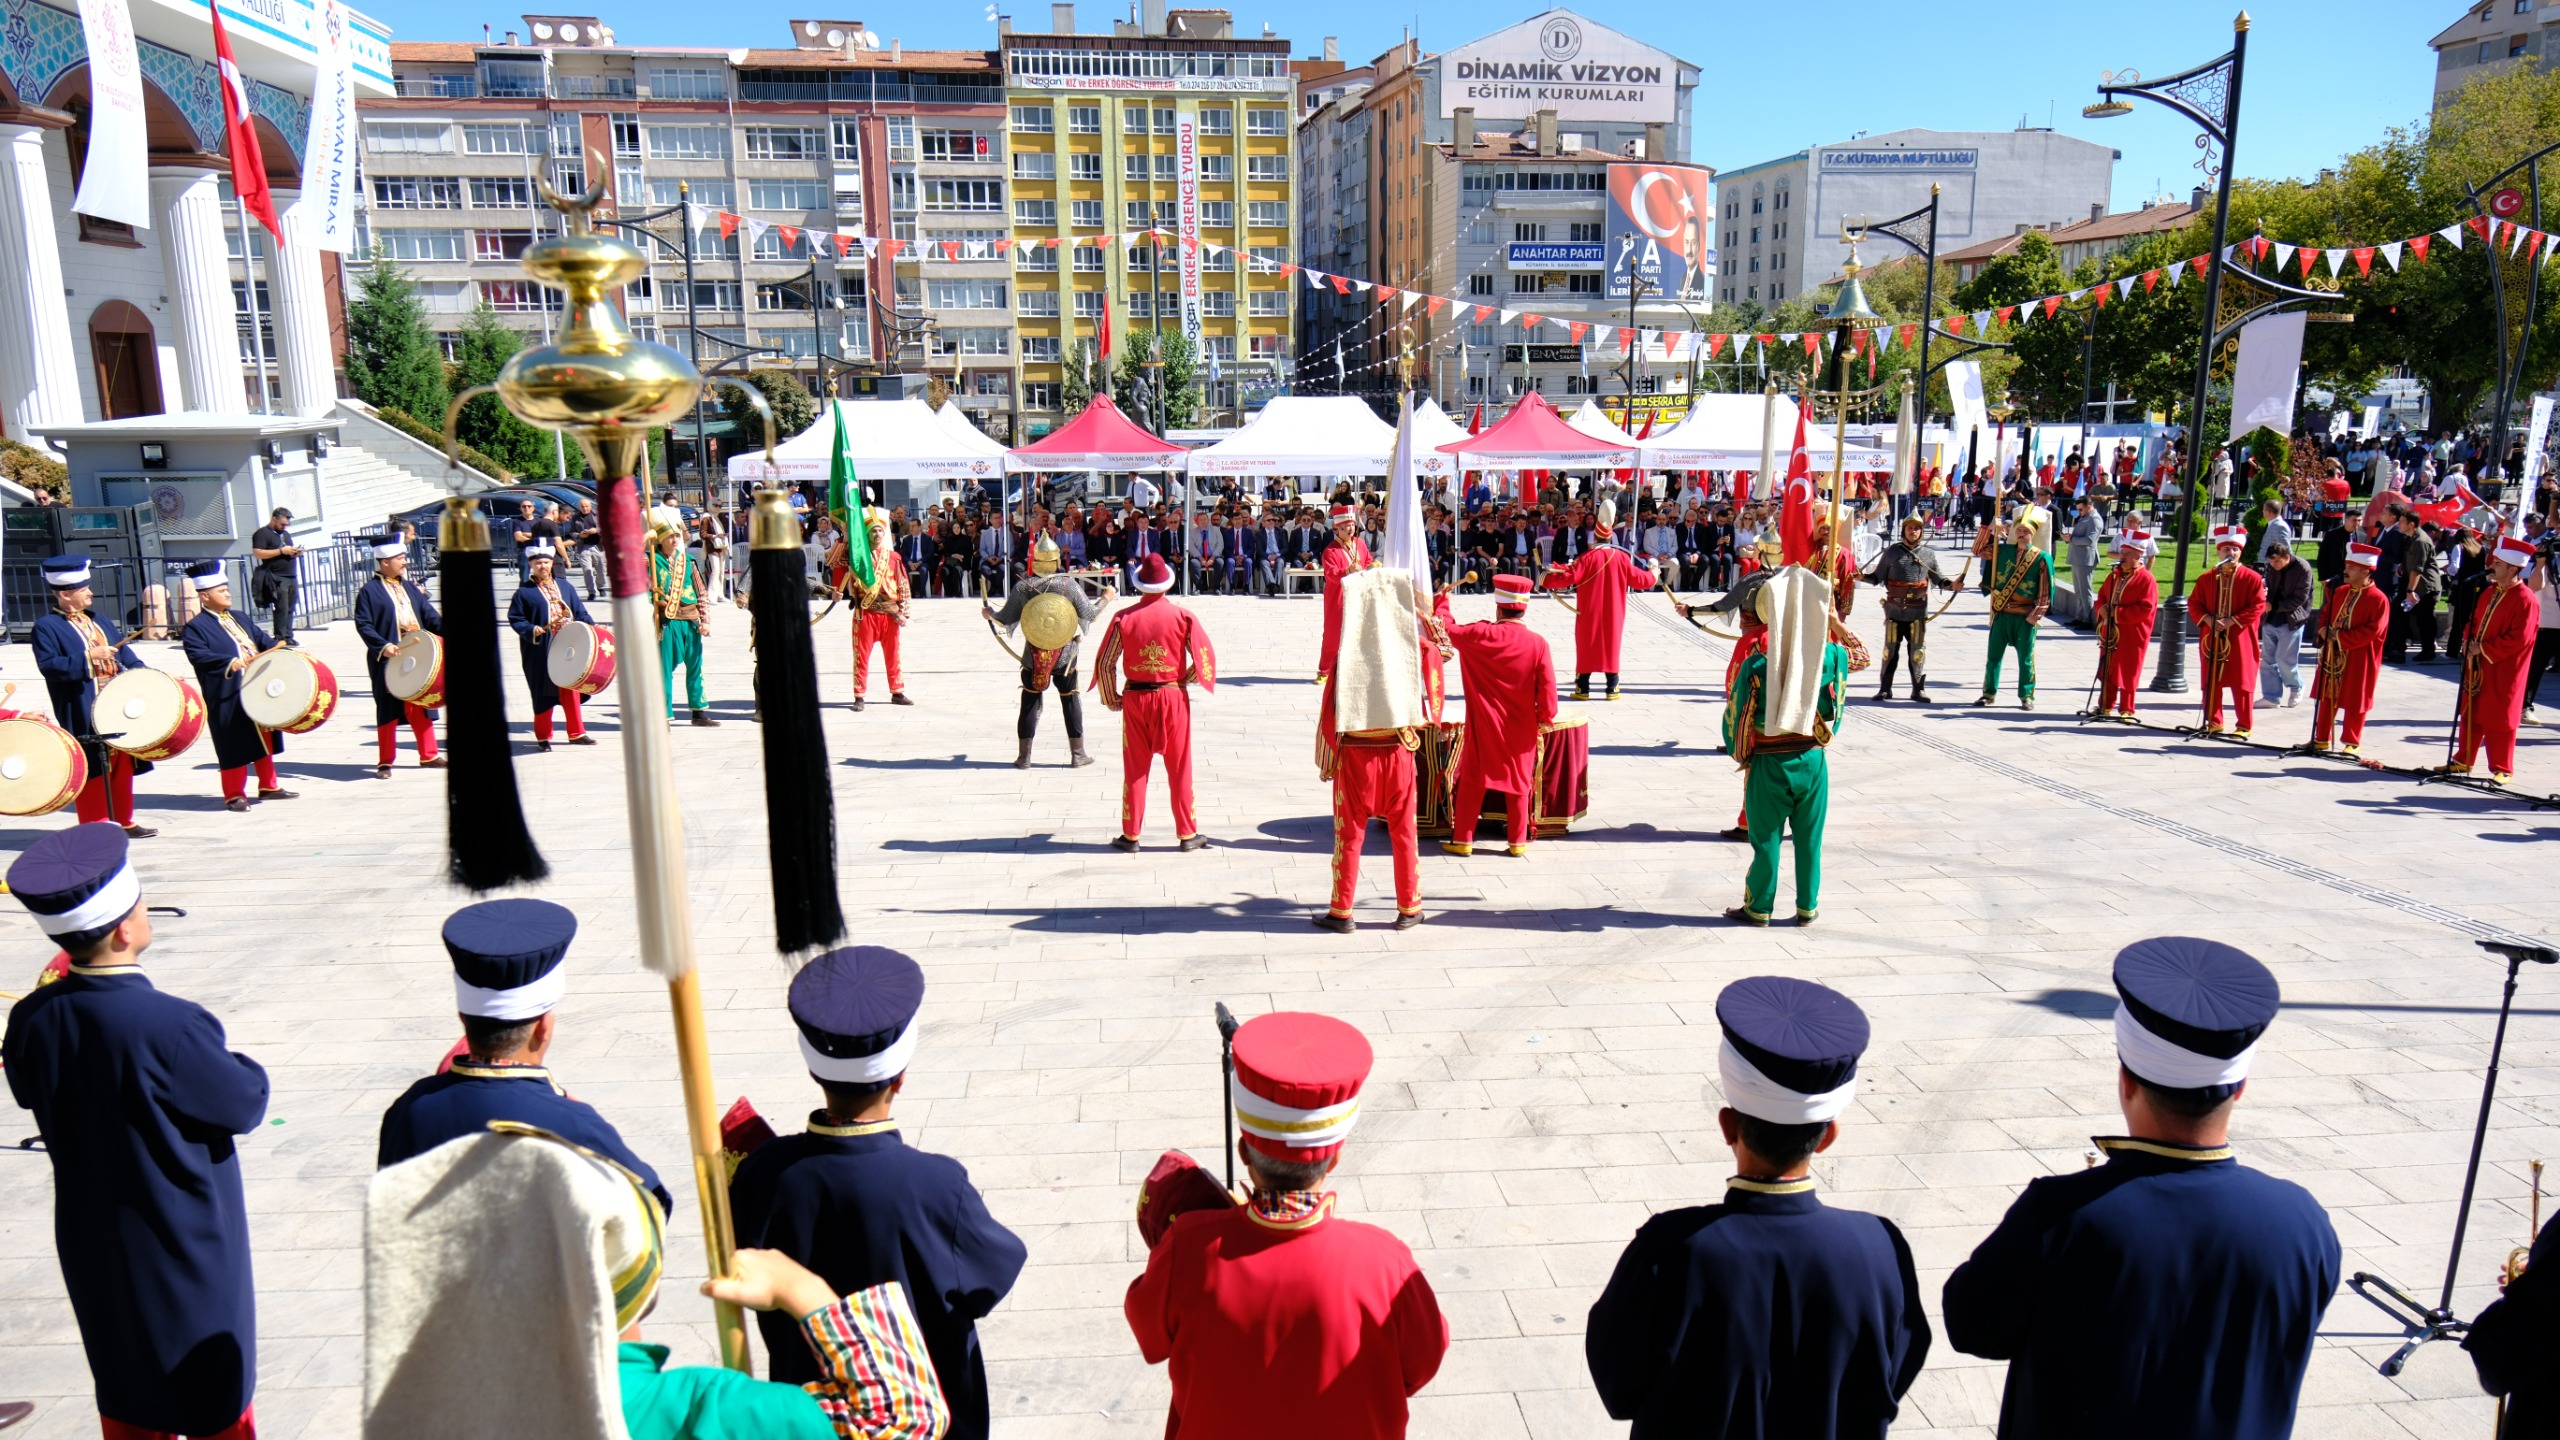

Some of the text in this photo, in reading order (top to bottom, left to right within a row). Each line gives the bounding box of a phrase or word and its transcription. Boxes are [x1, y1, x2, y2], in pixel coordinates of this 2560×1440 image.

[1554, 31, 1570, 48] D
[1457, 57, 1661, 83] DİNAMİK VİZYON
[1468, 83, 1644, 101] EĞİTİM KURUMLARI
[1181, 123, 1193, 175] YURDU
[1512, 248, 1567, 259] ANAHTAR
[1641, 239, 1661, 264] A
[1610, 285, 1631, 296] İLERİ
[1648, 396, 1674, 407] SERRA
